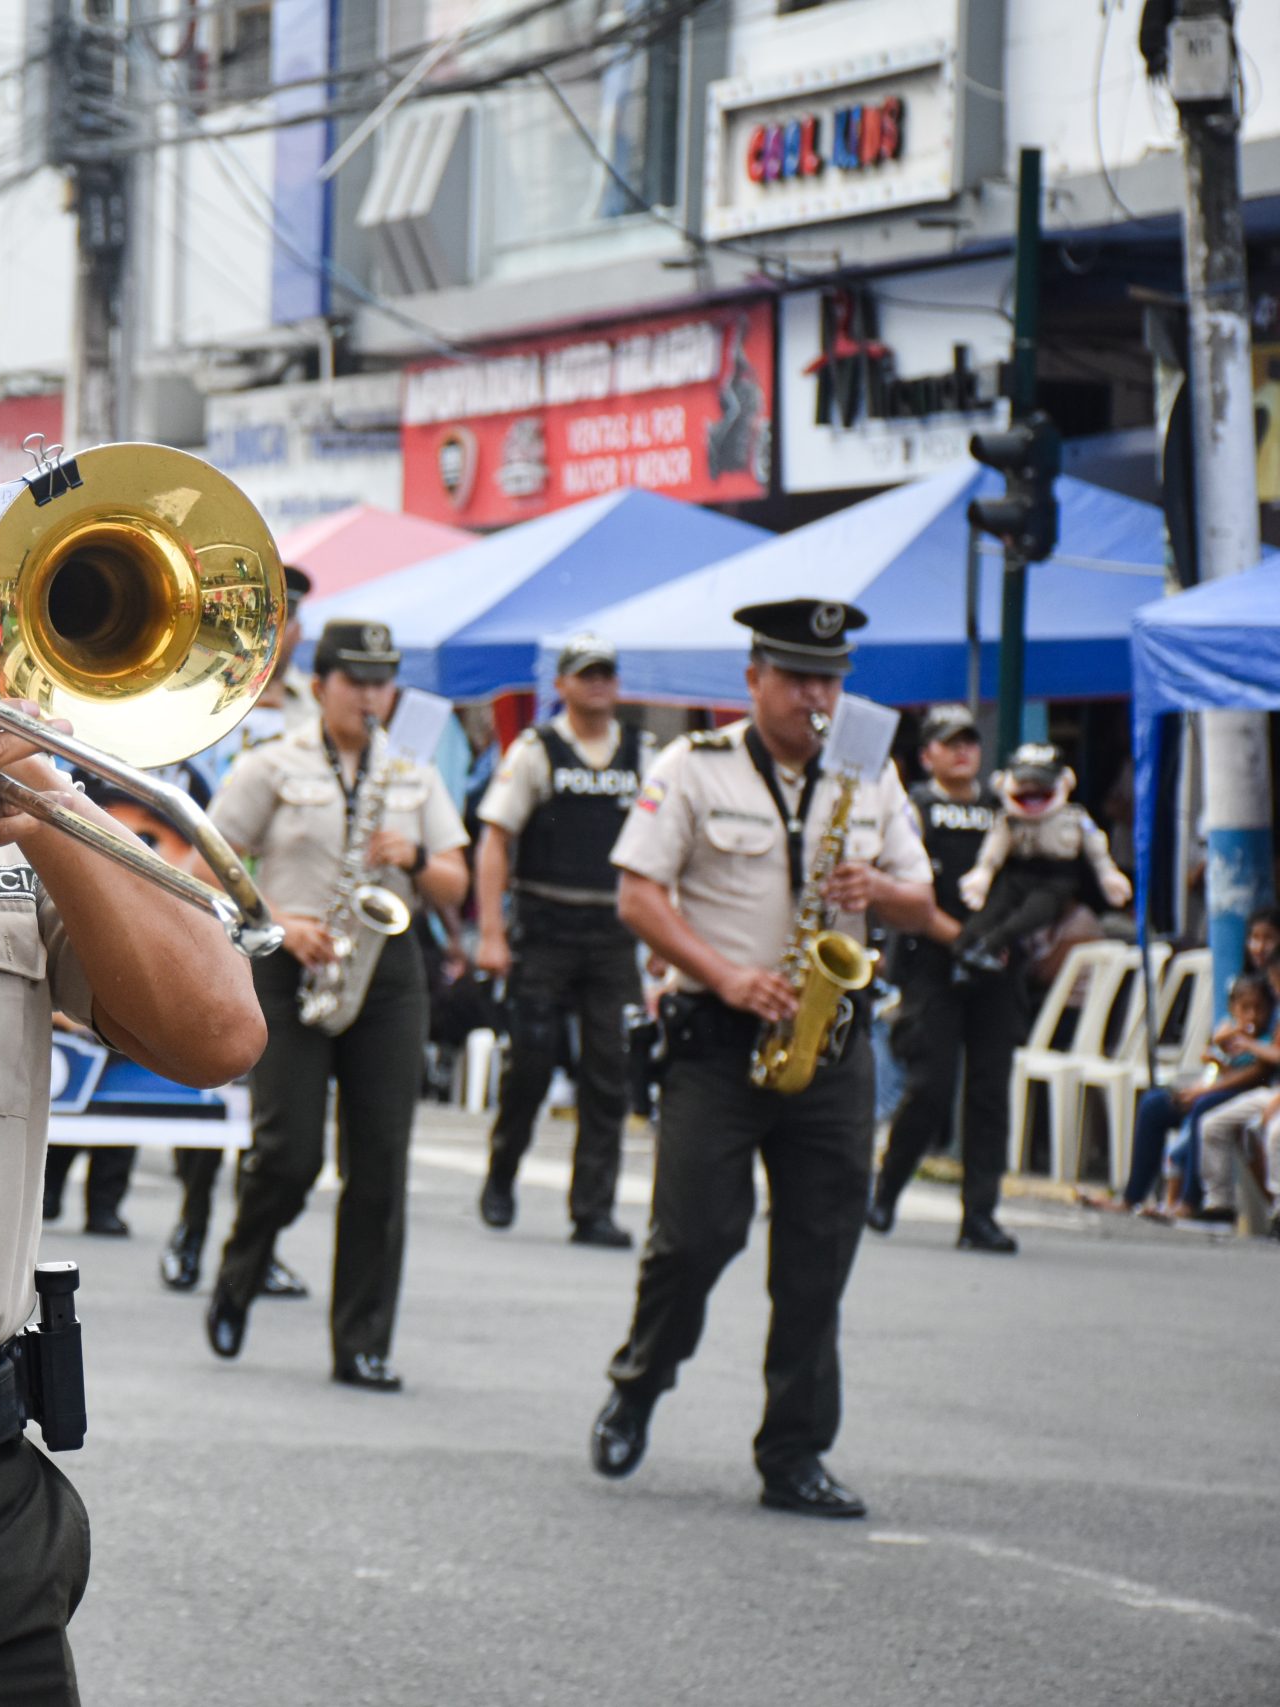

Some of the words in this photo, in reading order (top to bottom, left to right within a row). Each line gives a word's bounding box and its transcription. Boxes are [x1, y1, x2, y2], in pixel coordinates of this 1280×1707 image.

[567, 412, 628, 455] VENTAS
[630, 411, 652, 448] AL
[652, 404, 686, 444] POR
[562, 456, 618, 496] MAYOR
[635, 446, 692, 488] MENOR
[554, 766, 639, 795] POLICIA
